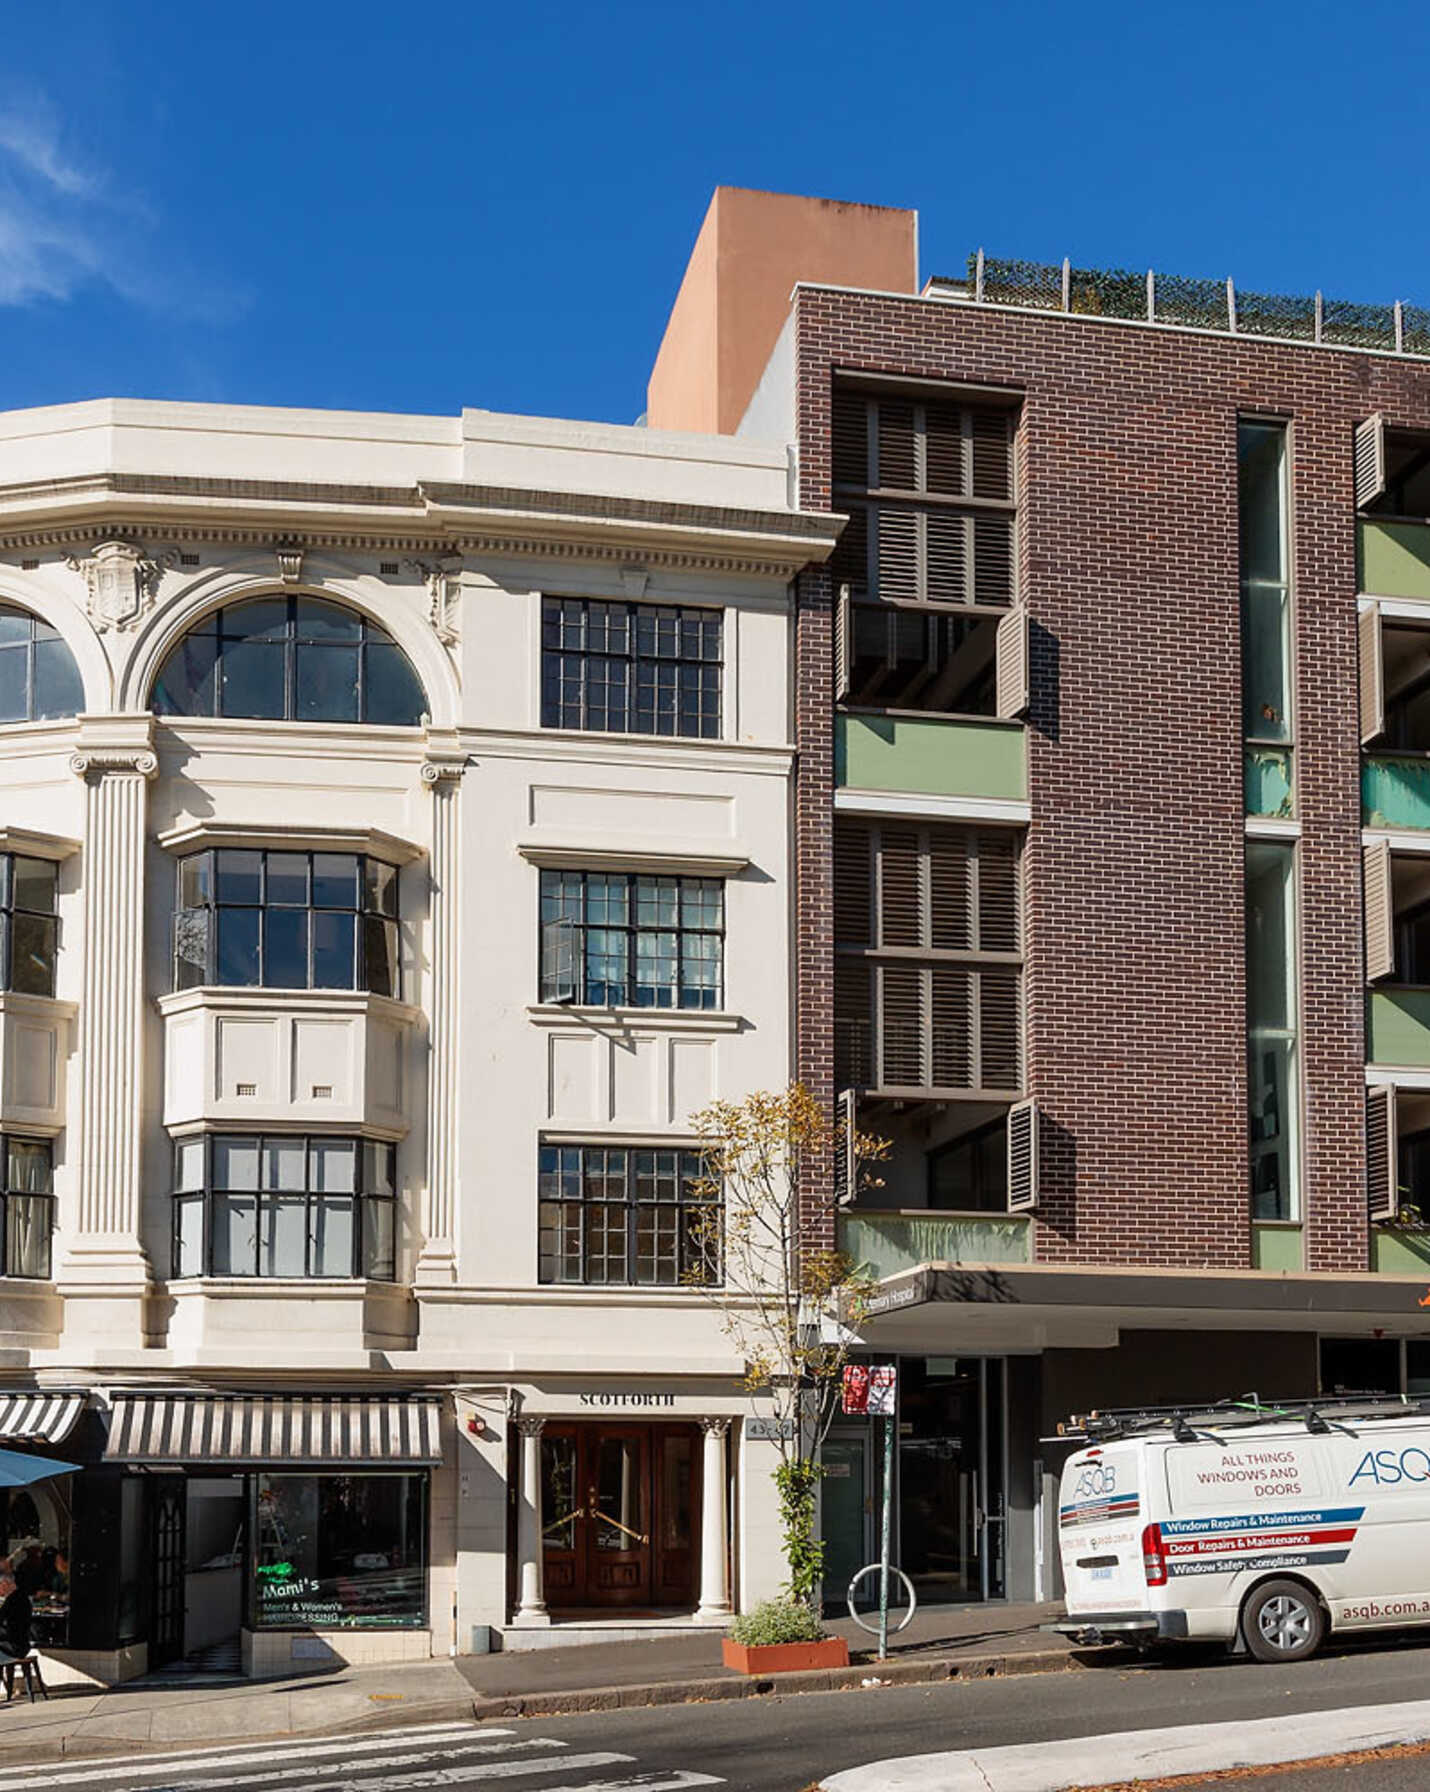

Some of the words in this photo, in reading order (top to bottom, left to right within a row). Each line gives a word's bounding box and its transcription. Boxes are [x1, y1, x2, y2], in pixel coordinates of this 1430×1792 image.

[580, 1393, 675, 1406] SCOTFORTH
[1222, 1456, 1244, 1466] ALL
[1246, 1452, 1295, 1465] THINGS
[1348, 1448, 1430, 1486] ASQ
[1073, 1466, 1116, 1499] ASQB
[1197, 1469, 1268, 1483] WINDOWS
[1270, 1467, 1298, 1479] AND
[1255, 1483, 1302, 1497] DOORS
[1166, 1521, 1209, 1533] Window
[1210, 1517, 1248, 1529] Repairs
[1249, 1516, 1258, 1526] &
[1259, 1513, 1322, 1525] Maintenance
[1169, 1544, 1195, 1554] Door
[1198, 1539, 1236, 1551] Repairs
[1237, 1539, 1246, 1548] &
[1246, 1536, 1310, 1547] Maintenance
[1173, 1563, 1216, 1575] Window
[1248, 1556, 1308, 1569] Compliance
[262, 1577, 319, 1599] Mami's
[291, 1602, 299, 1611] &
[301, 1602, 343, 1612] Women's
[1343, 1601, 1430, 1619] asqb.com.a
